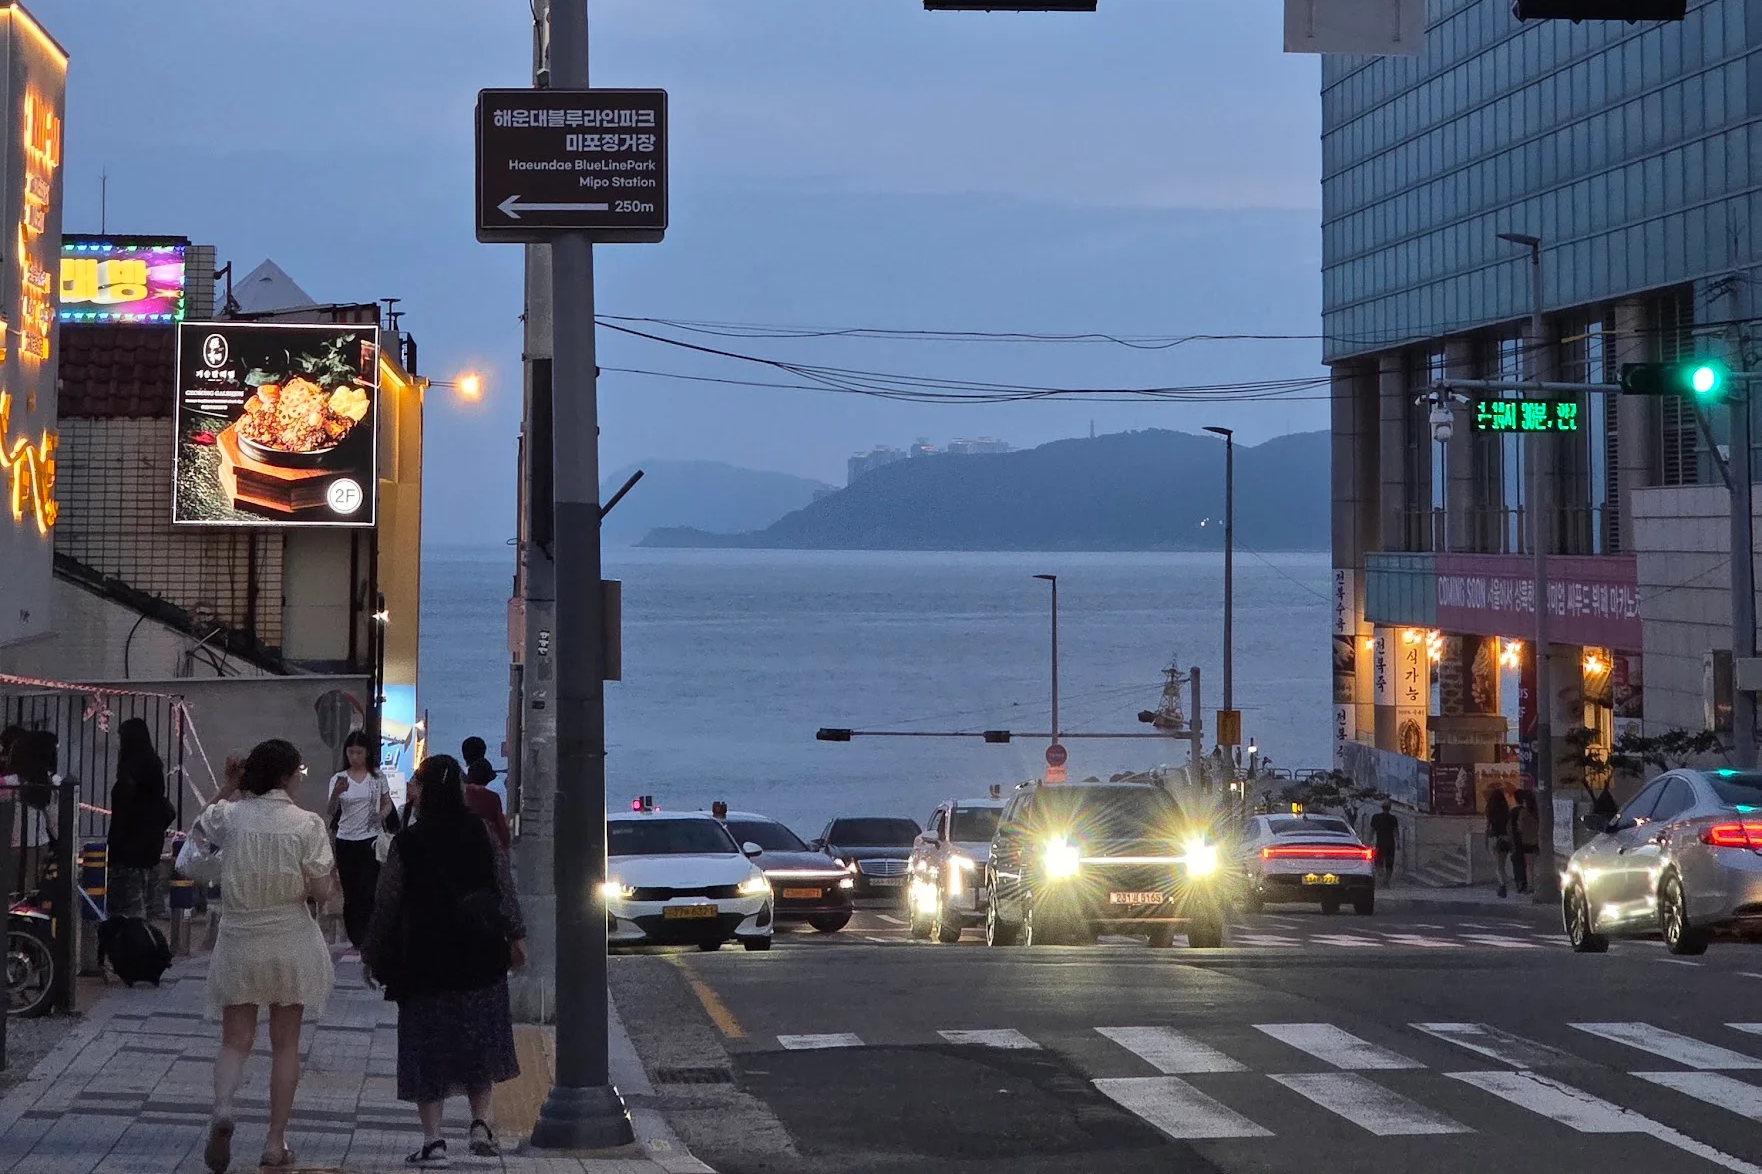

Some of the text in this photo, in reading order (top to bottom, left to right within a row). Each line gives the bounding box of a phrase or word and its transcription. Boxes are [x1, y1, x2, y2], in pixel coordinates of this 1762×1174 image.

[493, 109, 656, 127] 해운대블루라인파크
[566, 134, 656, 152] 미포정거장
[509, 159, 656, 171] Haeundae BlueLinePark
[579, 176, 656, 189] Mipo Station
[615, 201, 654, 212] 250m
[335, 489, 356, 503] 2F
[1438, 575, 1465, 607] COMING
[1466, 577, 1486, 609] SOON
[1404, 629, 1420, 701] 식가능
